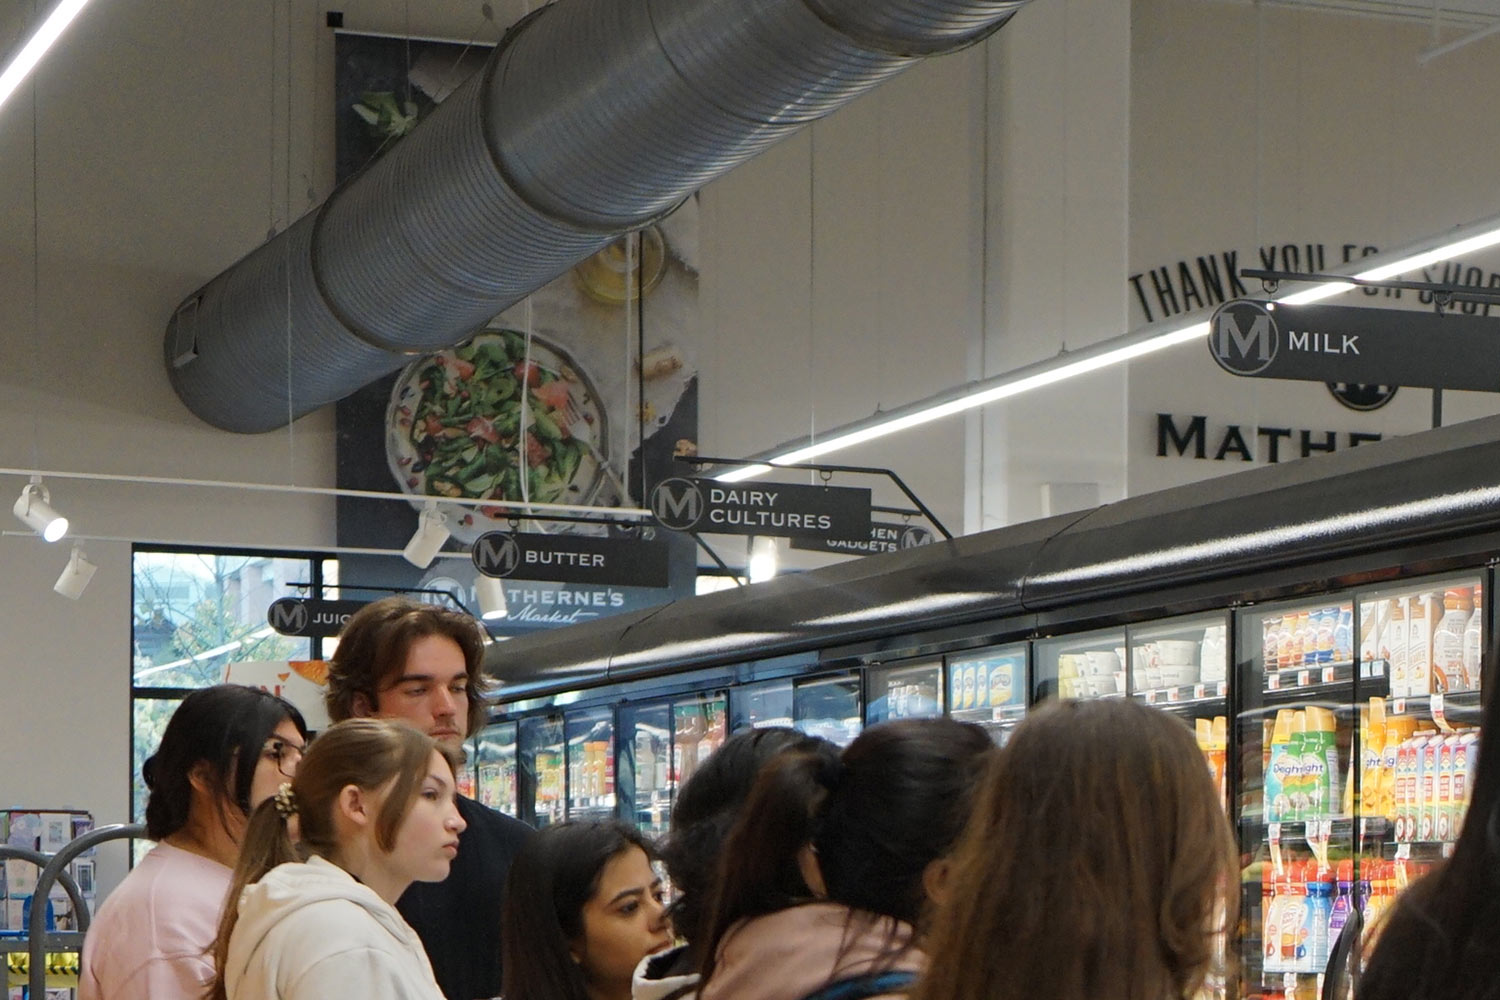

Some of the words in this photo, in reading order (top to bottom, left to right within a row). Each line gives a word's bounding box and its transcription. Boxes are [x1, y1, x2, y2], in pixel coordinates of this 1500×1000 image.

[1129, 250, 1247, 322] THANK
[1288, 331, 1361, 355] MILK
[710, 488, 779, 507] DAIRY
[710, 509, 832, 530] CULTURES
[525, 550, 605, 567] BUTTER
[506, 606, 599, 625] Market
